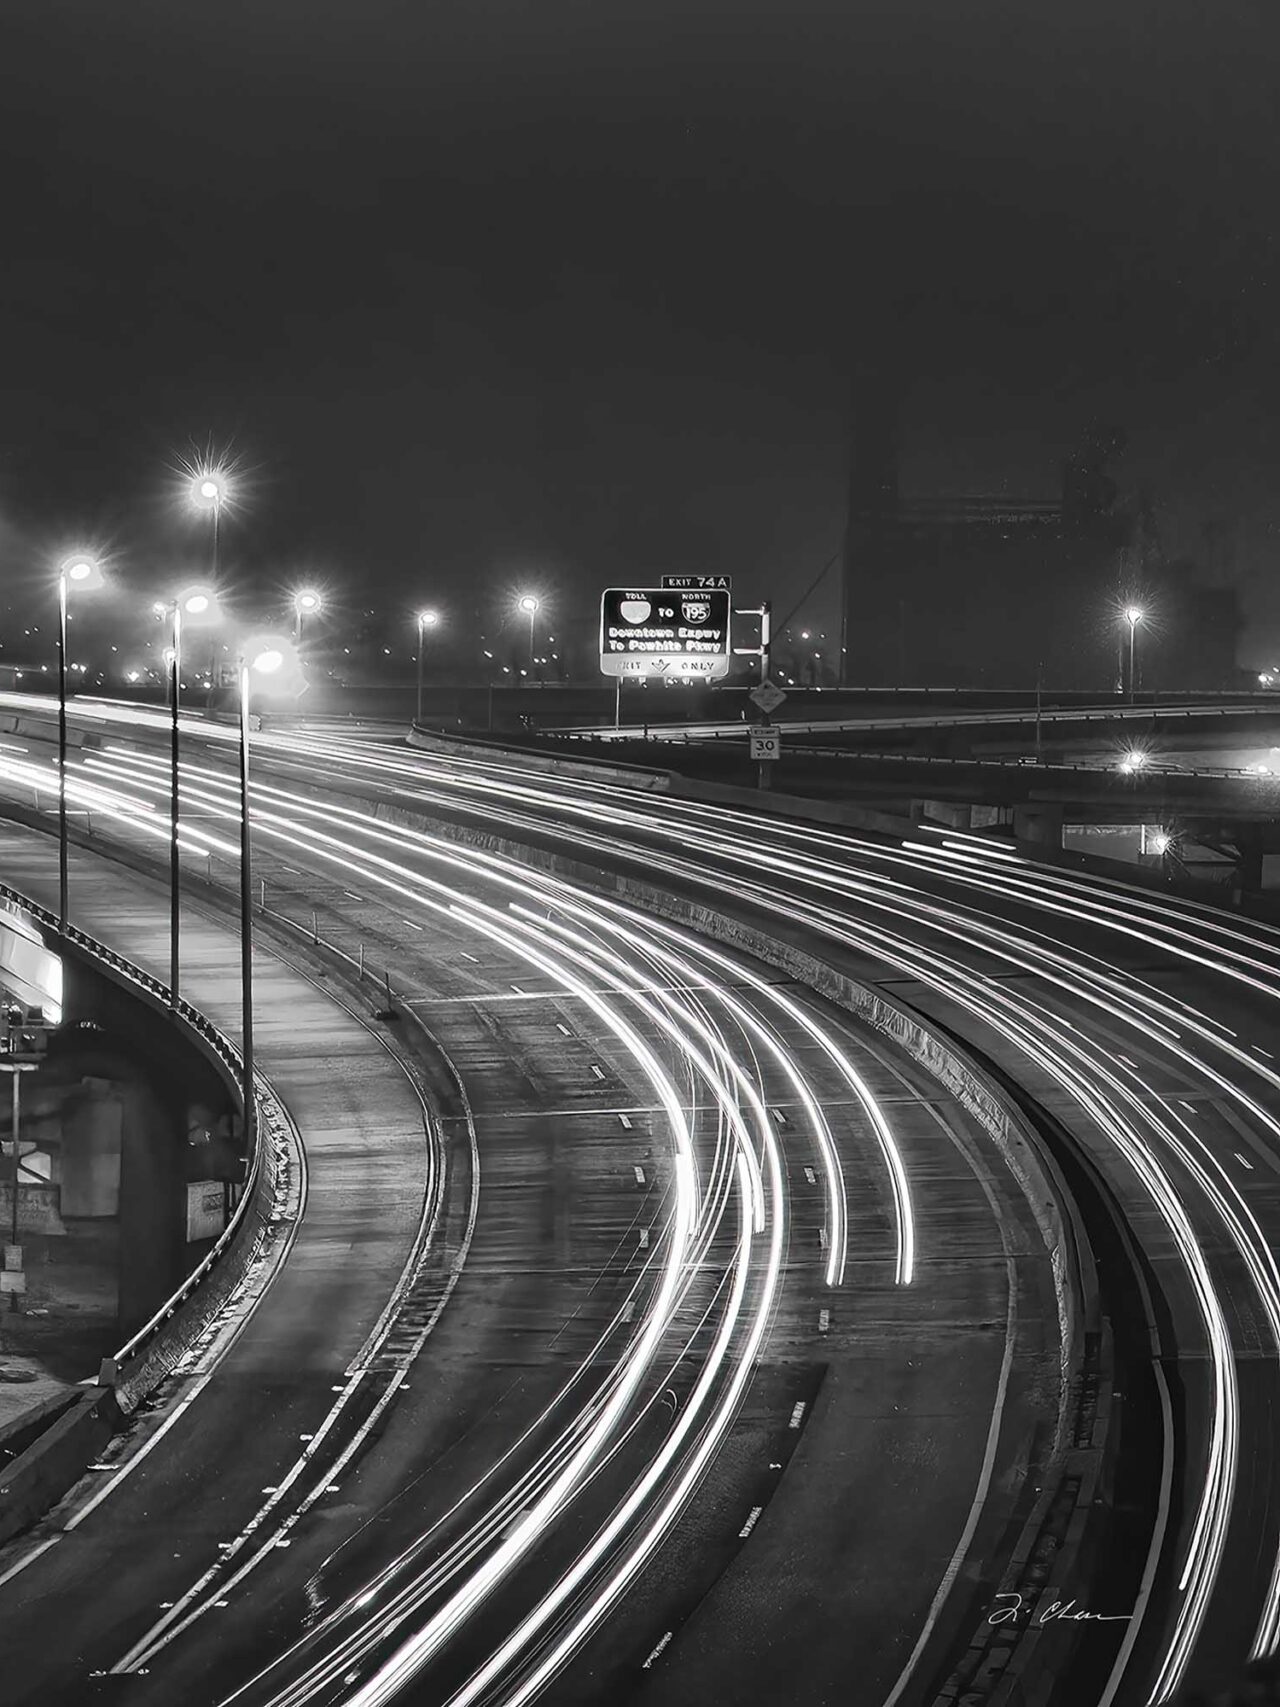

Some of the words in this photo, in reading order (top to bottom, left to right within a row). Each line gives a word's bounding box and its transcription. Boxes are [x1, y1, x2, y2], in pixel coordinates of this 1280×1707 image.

[668, 578, 692, 586] EXIT
[625, 592, 647, 600] TOLL
[686, 607, 707, 619] 195
[608, 627, 674, 638] Downtown
[609, 640, 625, 651] To
[628, 640, 682, 651] Powhite
[685, 640, 721, 653] Pkwy
[616, 662, 641, 670] XIT
[681, 662, 714, 670] ONLY
[756, 740, 775, 751] 30
